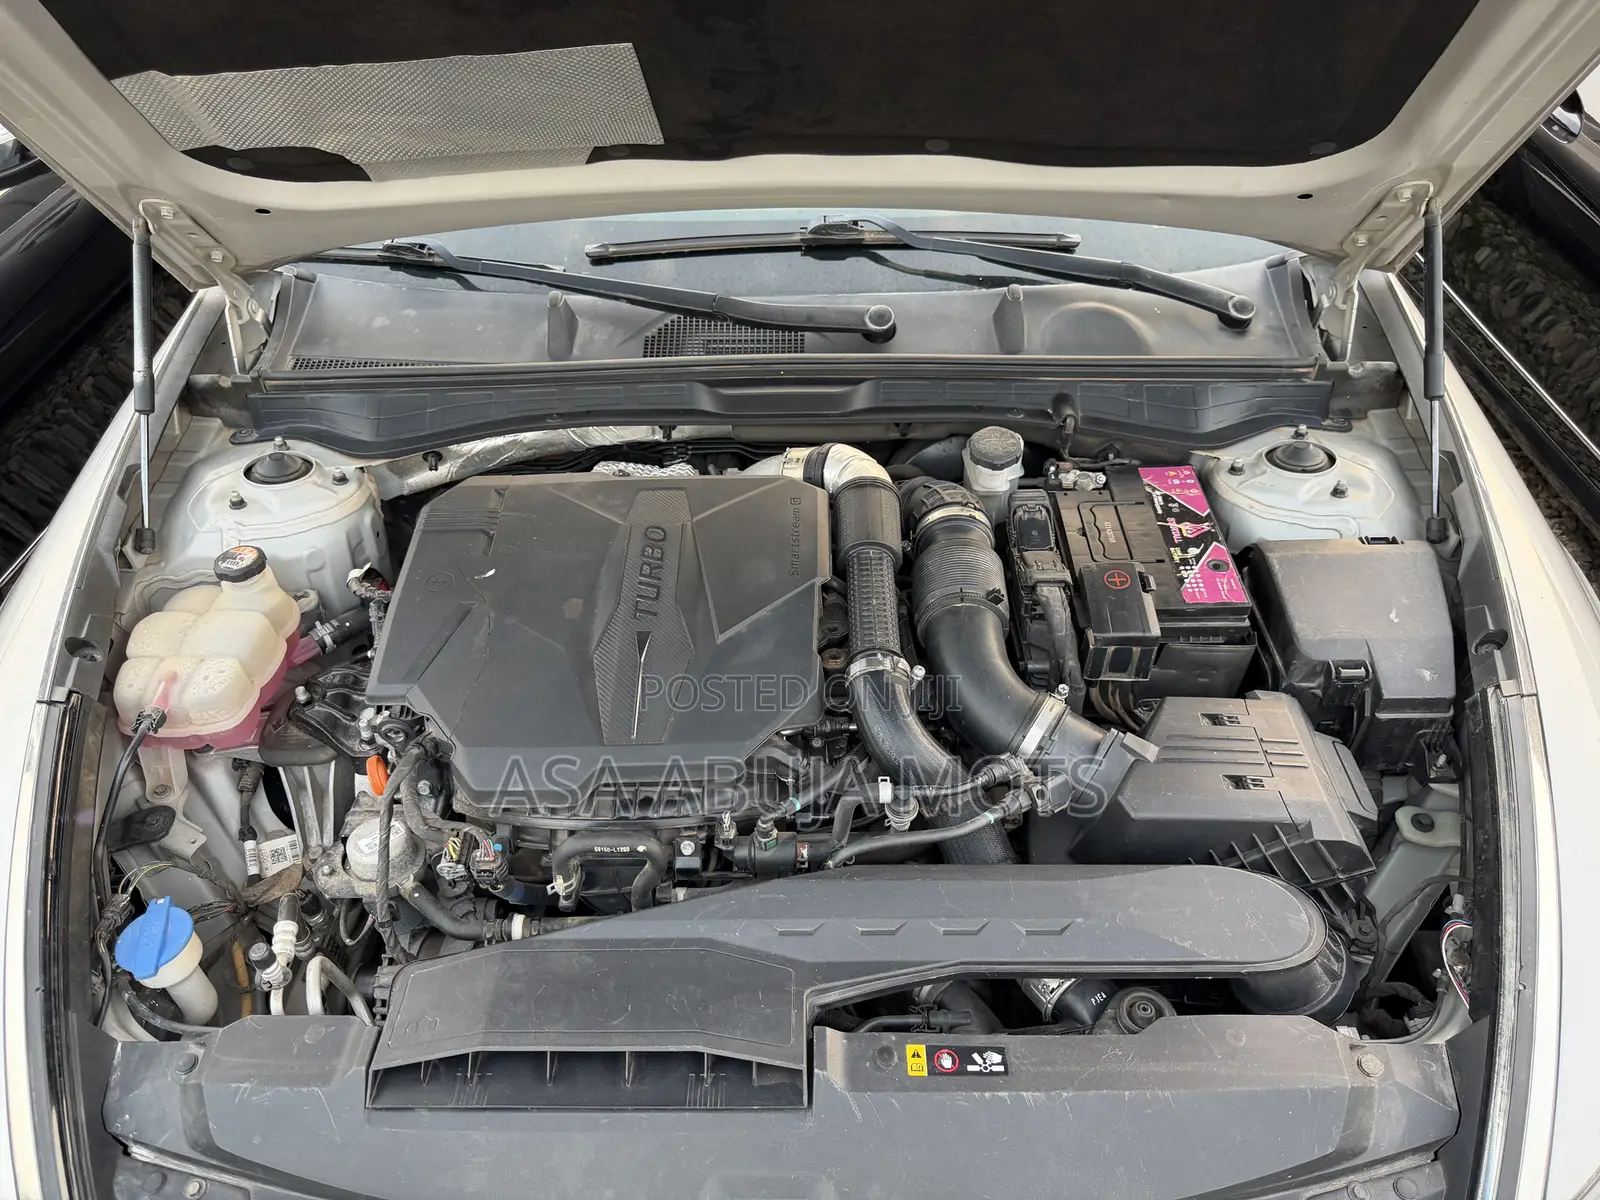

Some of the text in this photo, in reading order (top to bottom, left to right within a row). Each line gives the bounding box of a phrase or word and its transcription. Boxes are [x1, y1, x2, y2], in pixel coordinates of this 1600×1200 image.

[633, 525, 667, 621] TURBO
[788, 507, 801, 577] Smartstream
[1090, 991, 1107, 1006] PJEA
